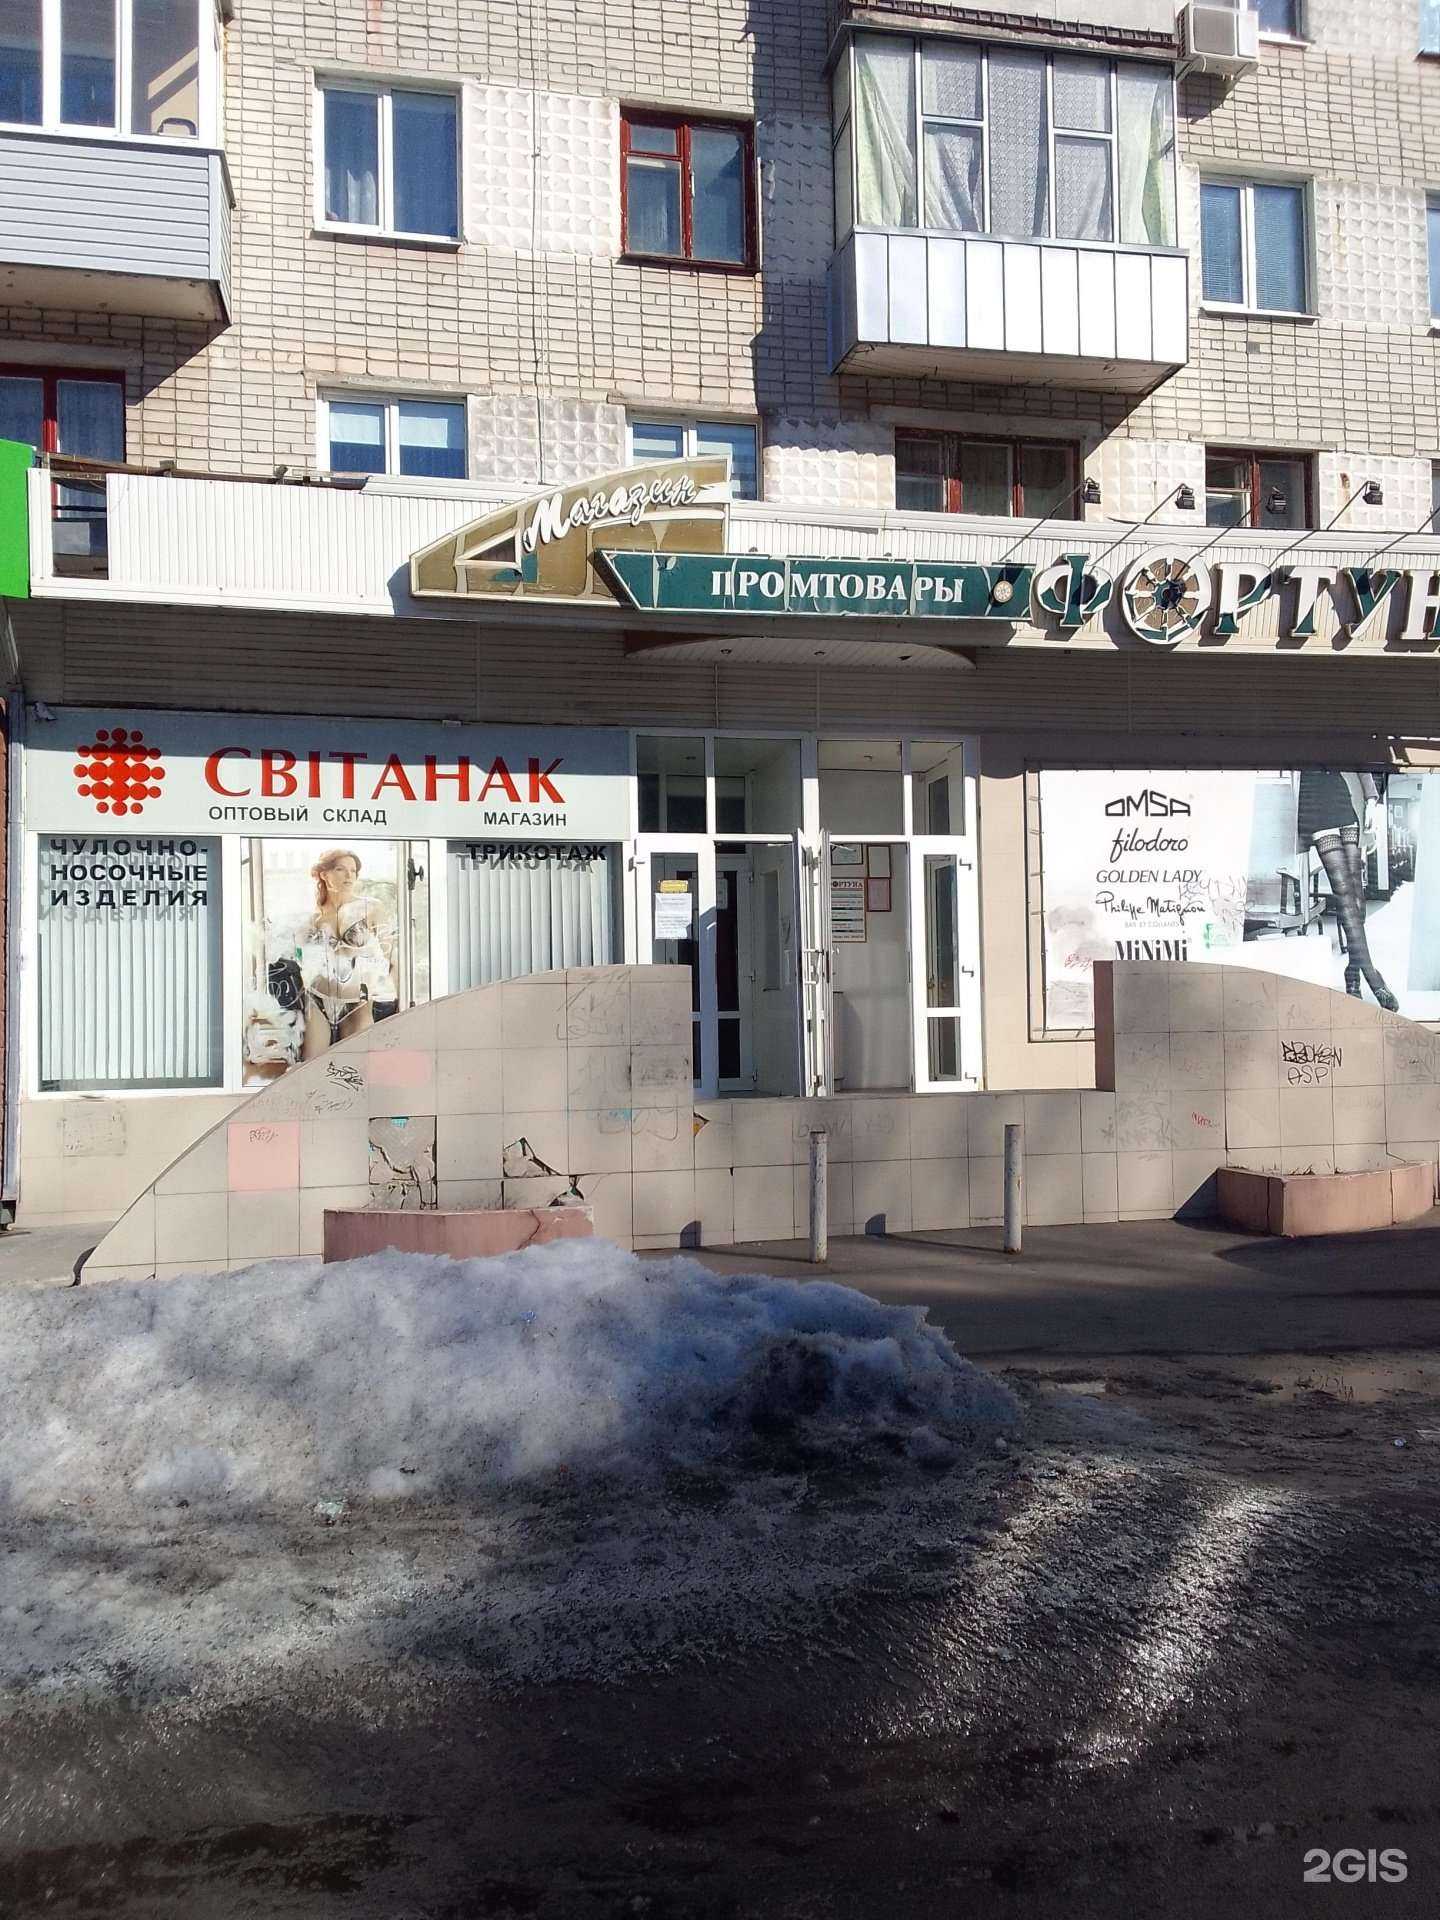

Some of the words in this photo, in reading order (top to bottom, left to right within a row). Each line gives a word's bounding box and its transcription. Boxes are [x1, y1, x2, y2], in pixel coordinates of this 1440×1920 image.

[522, 475, 697, 553] Магазин
[711, 571, 965, 603] ПРОМТОВАРЫ
[204, 746, 566, 804] СВІТАНАК
[1105, 789, 1191, 817] OMSA
[208, 805, 309, 822] ОПТОВЫЙ
[322, 808, 388, 825] СКЛАД
[483, 811, 568, 827] МАГАЗИН
[50, 838, 208, 856] ЧУЛОЧНО-
[465, 843, 607, 861] ТРИКОТАЖ
[1109, 827, 1189, 863] filodoro
[50, 864, 208, 881] НОСОЧНЫЕ
[1096, 869, 1160, 883] GOLDEN
[1162, 869, 1202, 883] LADY
[50, 889, 208, 910] ИЗДЕЛИЯ
[1287, 1065, 1328, 1085] ASP
